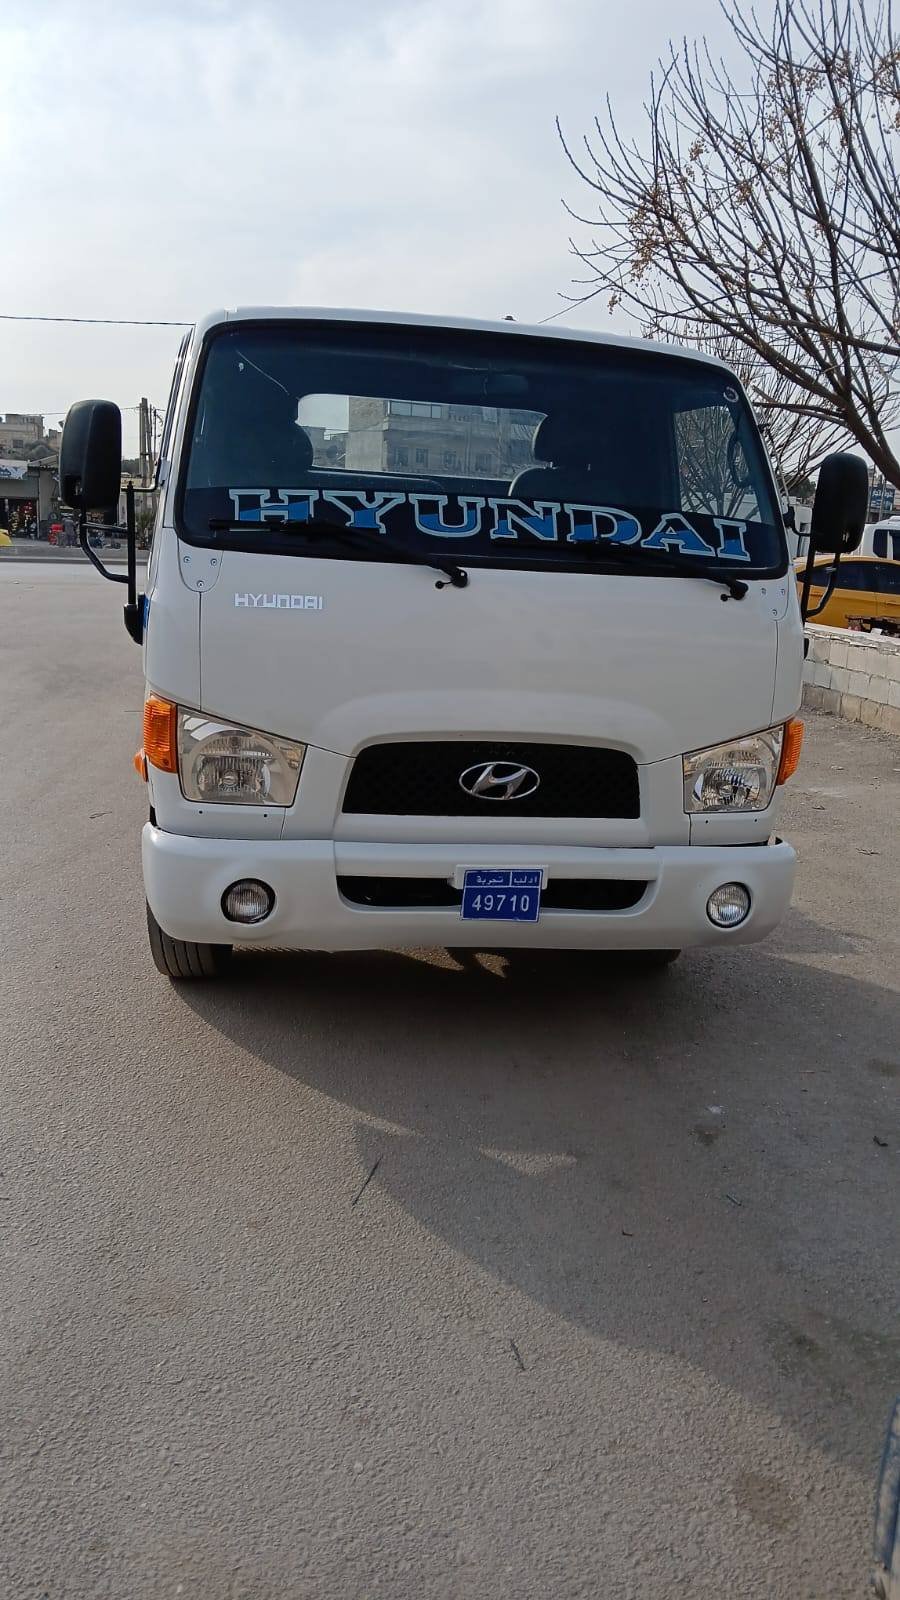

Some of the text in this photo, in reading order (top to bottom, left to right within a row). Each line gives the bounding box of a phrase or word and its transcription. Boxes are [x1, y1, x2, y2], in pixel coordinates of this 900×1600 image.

[228, 488, 751, 561] HYUNDAI
[234, 593, 323, 610] HYUNDAI
[471, 894, 530, 912] 49710
